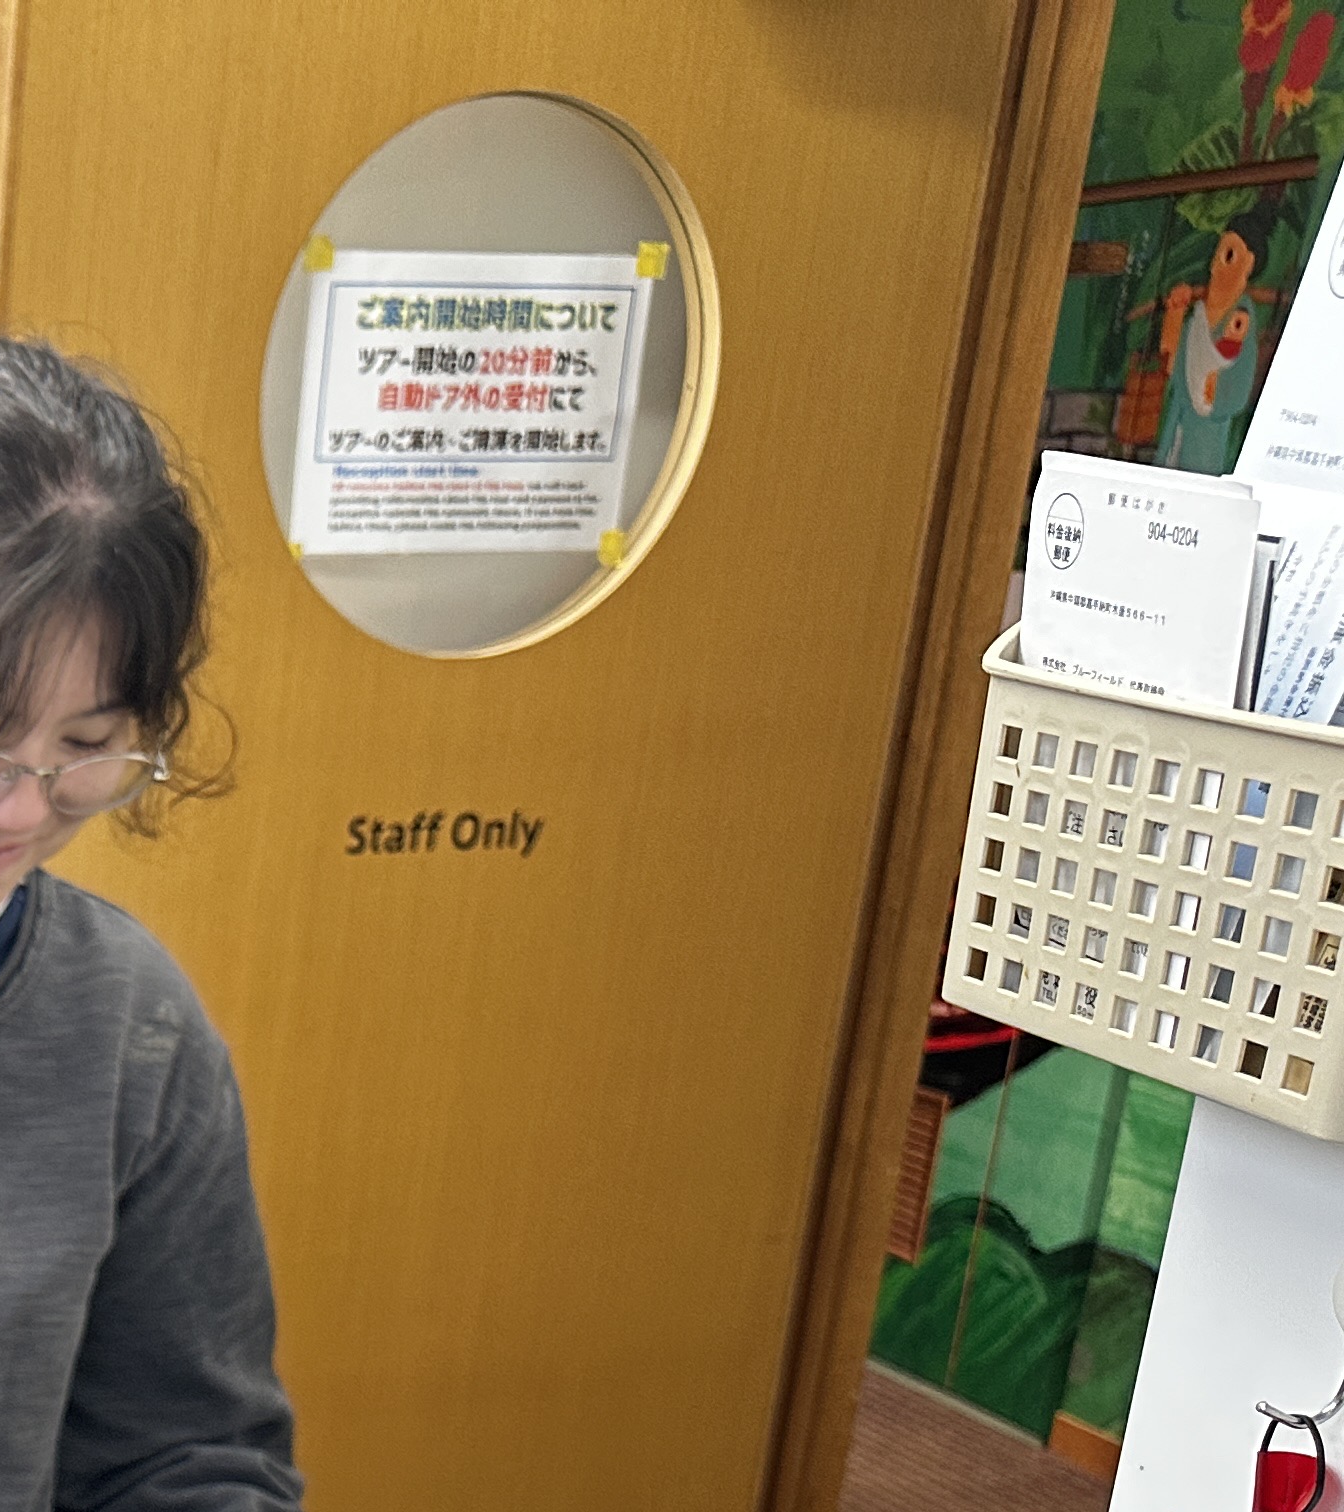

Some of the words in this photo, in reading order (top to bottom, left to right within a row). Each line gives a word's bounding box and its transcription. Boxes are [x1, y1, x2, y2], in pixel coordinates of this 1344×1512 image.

[356, 295, 618, 332] ご案内開始時間について
[358, 344, 598, 377] ツアー開始の20分前から、
[377, 382, 585, 414] 自動ドア外の受付にて
[1148, 522, 1199, 548] 904-0204
[1053, 545, 1071, 562] 郵便
[345, 810, 445, 856] Staff
[450, 808, 544, 858] Only
